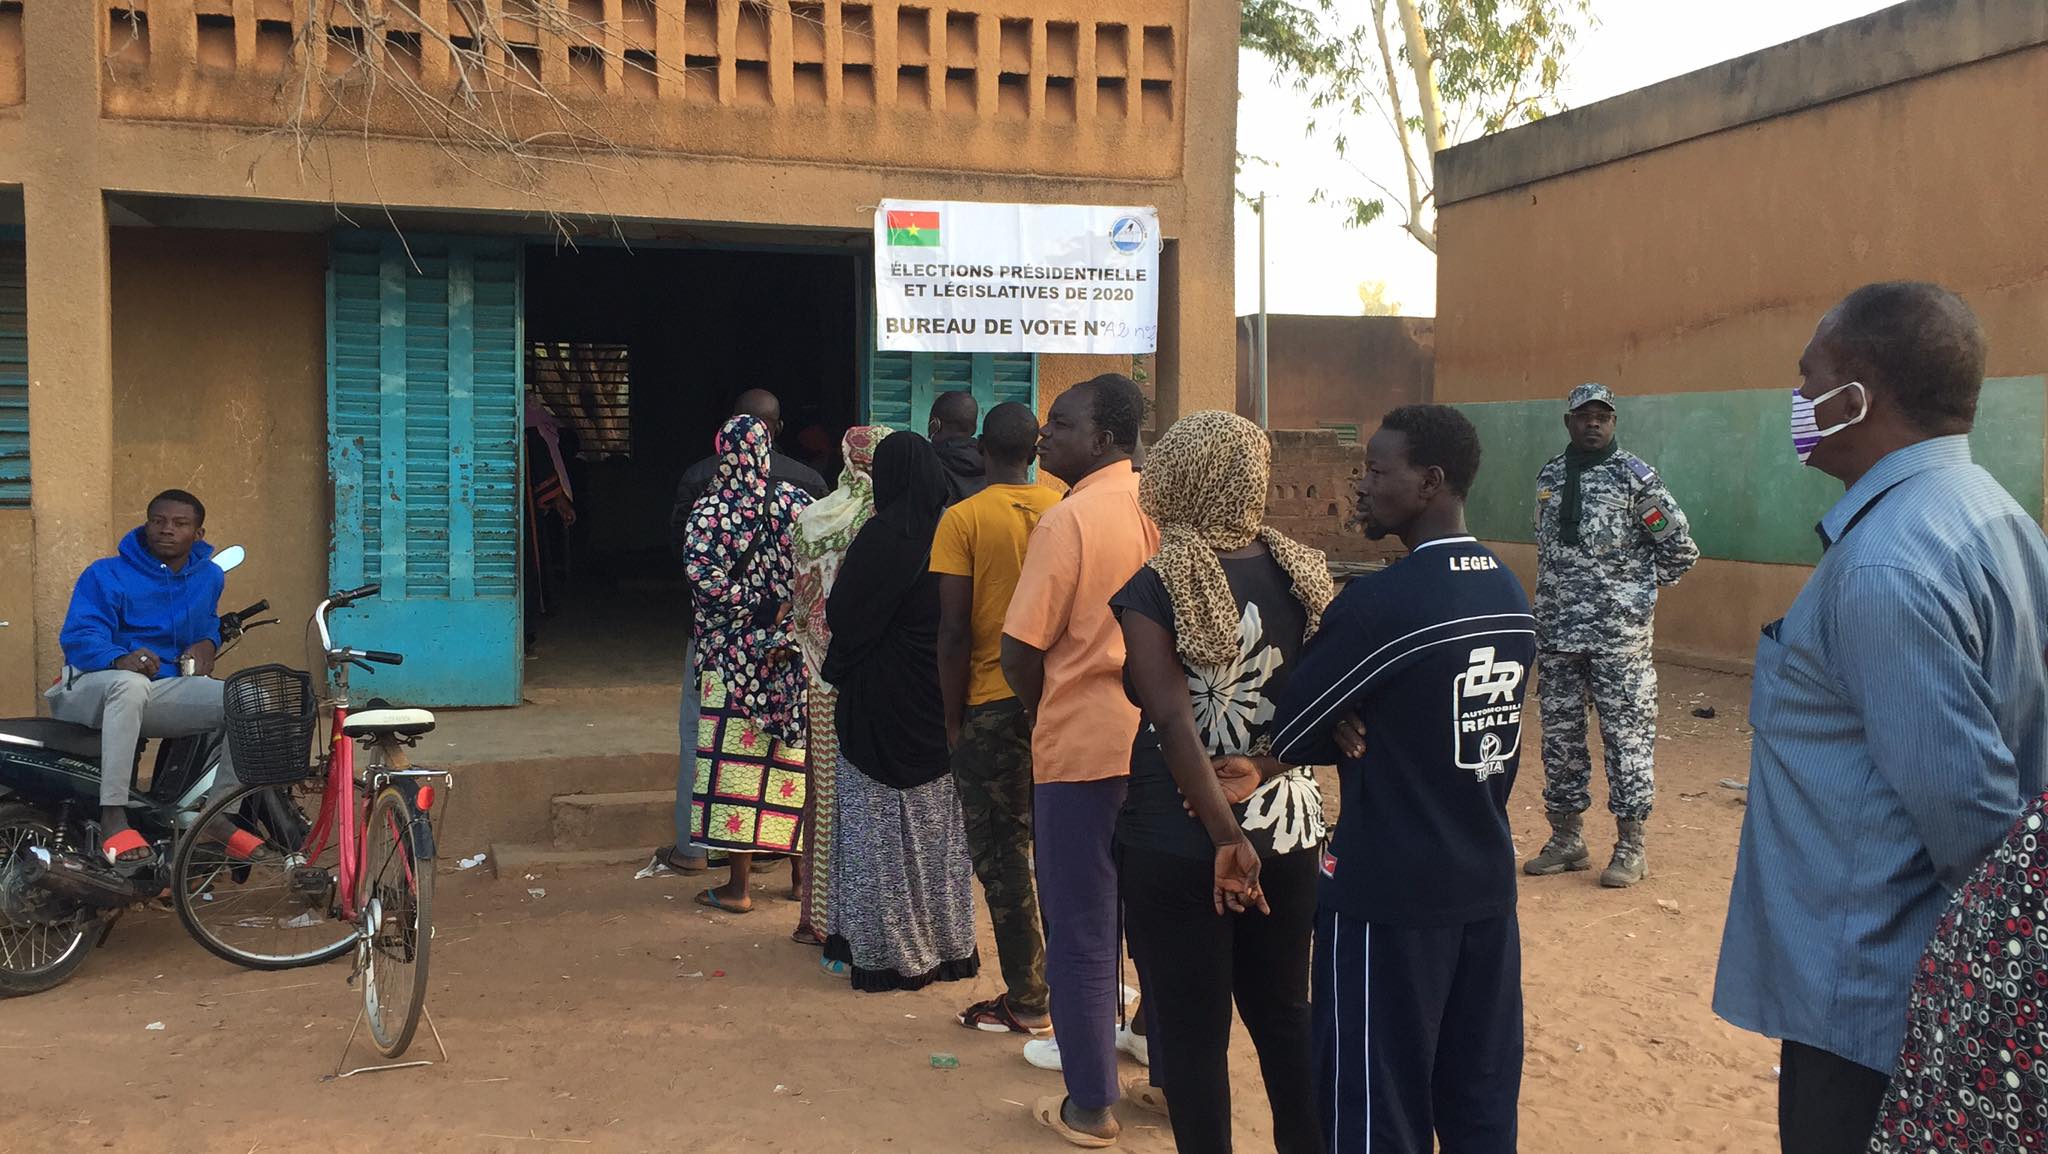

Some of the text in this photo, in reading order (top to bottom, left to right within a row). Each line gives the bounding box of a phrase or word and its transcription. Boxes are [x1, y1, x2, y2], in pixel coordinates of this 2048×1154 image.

[891, 261, 1147, 281] ÉLECTIONS PRÉSIDENTIELLE
[904, 281, 1134, 301] ET LÉGISLATIVES DE 2020
[886, 318, 976, 335] BUREAU
[984, 318, 1012, 335] DE
[1020, 319, 1077, 336] VOTE
[1449, 556, 1499, 571] LEGEA
[1461, 711, 1521, 733] REALE
